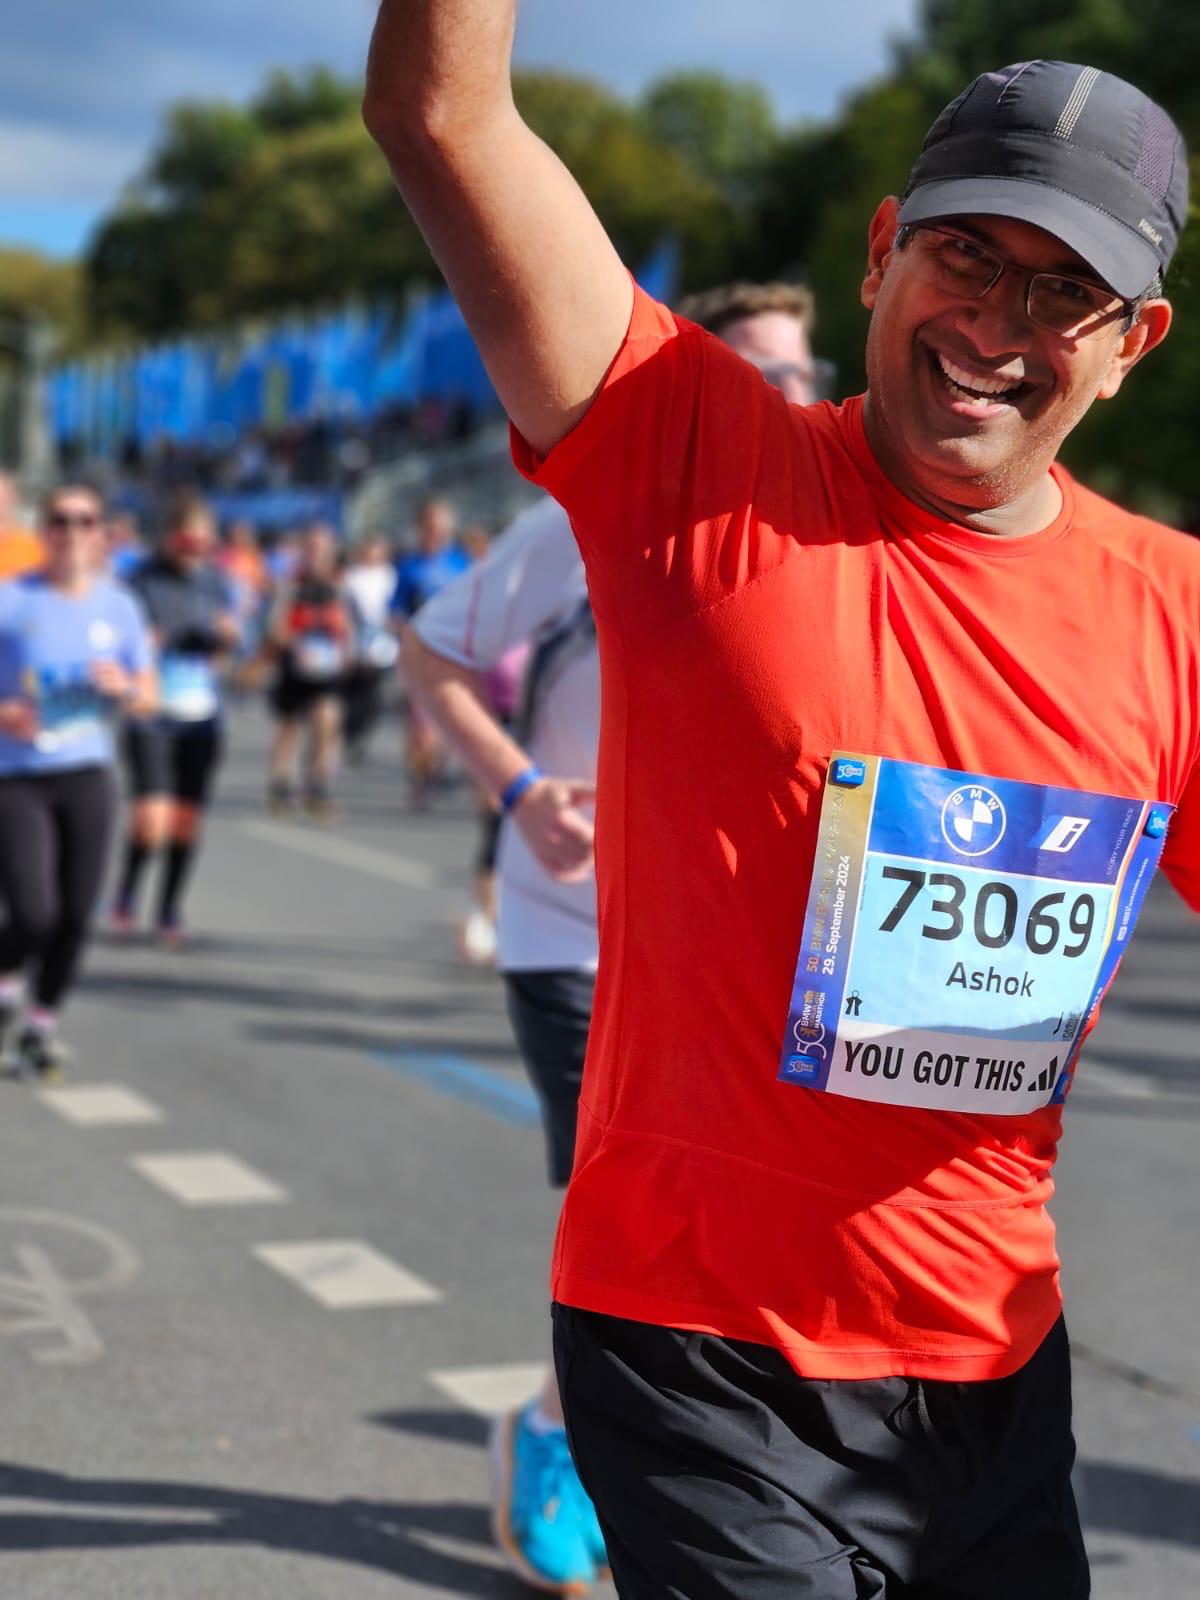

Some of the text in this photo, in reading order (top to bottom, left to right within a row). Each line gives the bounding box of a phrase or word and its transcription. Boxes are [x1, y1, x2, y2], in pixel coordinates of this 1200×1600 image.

[951, 788, 1000, 812] BMW
[1113, 828, 1127, 851] YOUR
[1122, 807, 1134, 829] RACE
[836, 855, 850, 887] 2024
[826, 887, 846, 954] September
[878, 865, 1095, 958] 73069
[822, 955, 836, 976] 29.
[945, 961, 1036, 997] Ashok
[800, 1003, 812, 1027] BMW
[813, 991, 826, 1029] MARATHON
[844, 1040, 1026, 1092] YOU GOT THIS
